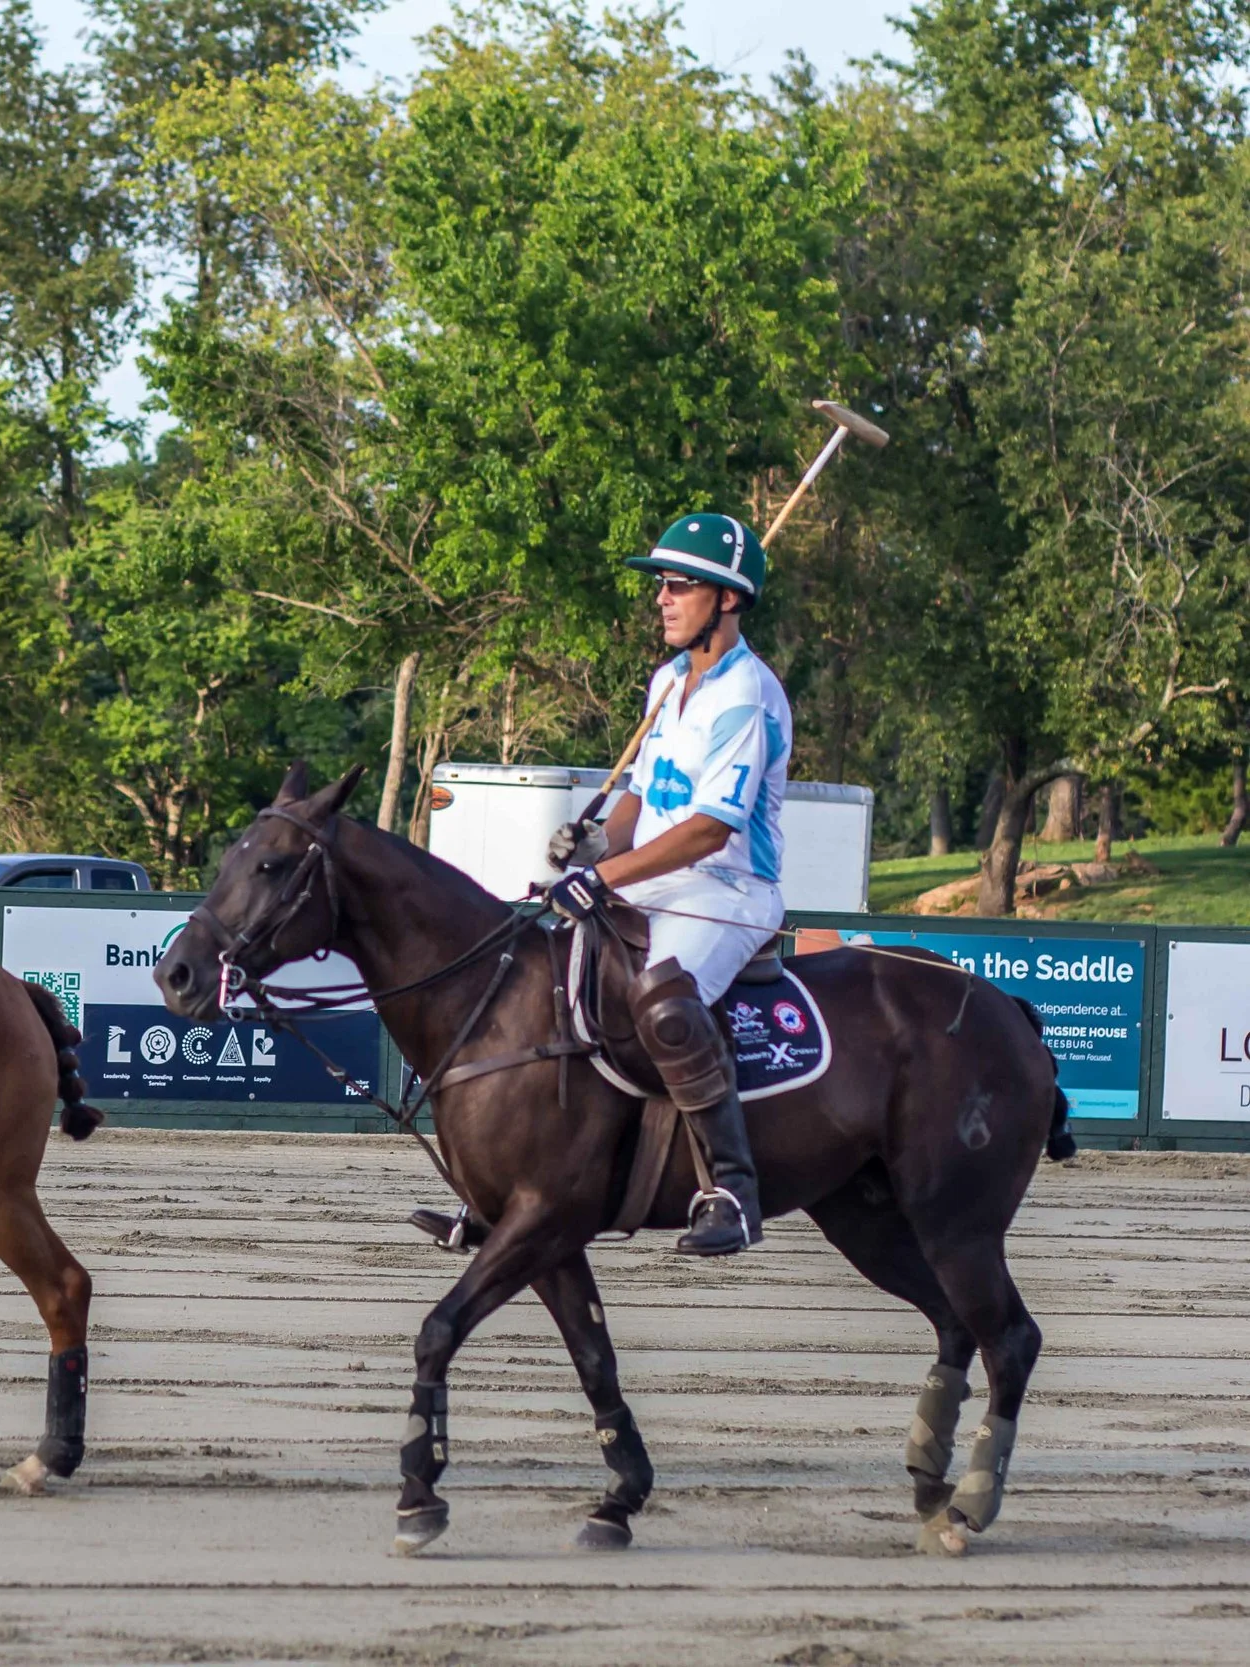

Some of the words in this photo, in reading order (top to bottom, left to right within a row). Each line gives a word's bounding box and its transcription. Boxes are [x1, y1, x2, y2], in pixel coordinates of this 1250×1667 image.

[721, 764, 750, 809] 1
[106, 944, 165, 967] Bank
[982, 951, 1029, 979] the
[1035, 954, 1134, 983] Saddle
[1042, 1026, 1087, 1037] INGSIDE
[1088, 1027, 1128, 1039] HOUSE
[1069, 1053, 1086, 1061] Team
[1086, 1053, 1113, 1062] Focused.
[142, 1074, 173, 1082] Outstanding
[182, 1074, 211, 1082] Community
[215, 1075, 246, 1083] Adaptability
[253, 1076, 272, 1084] Loyalty
